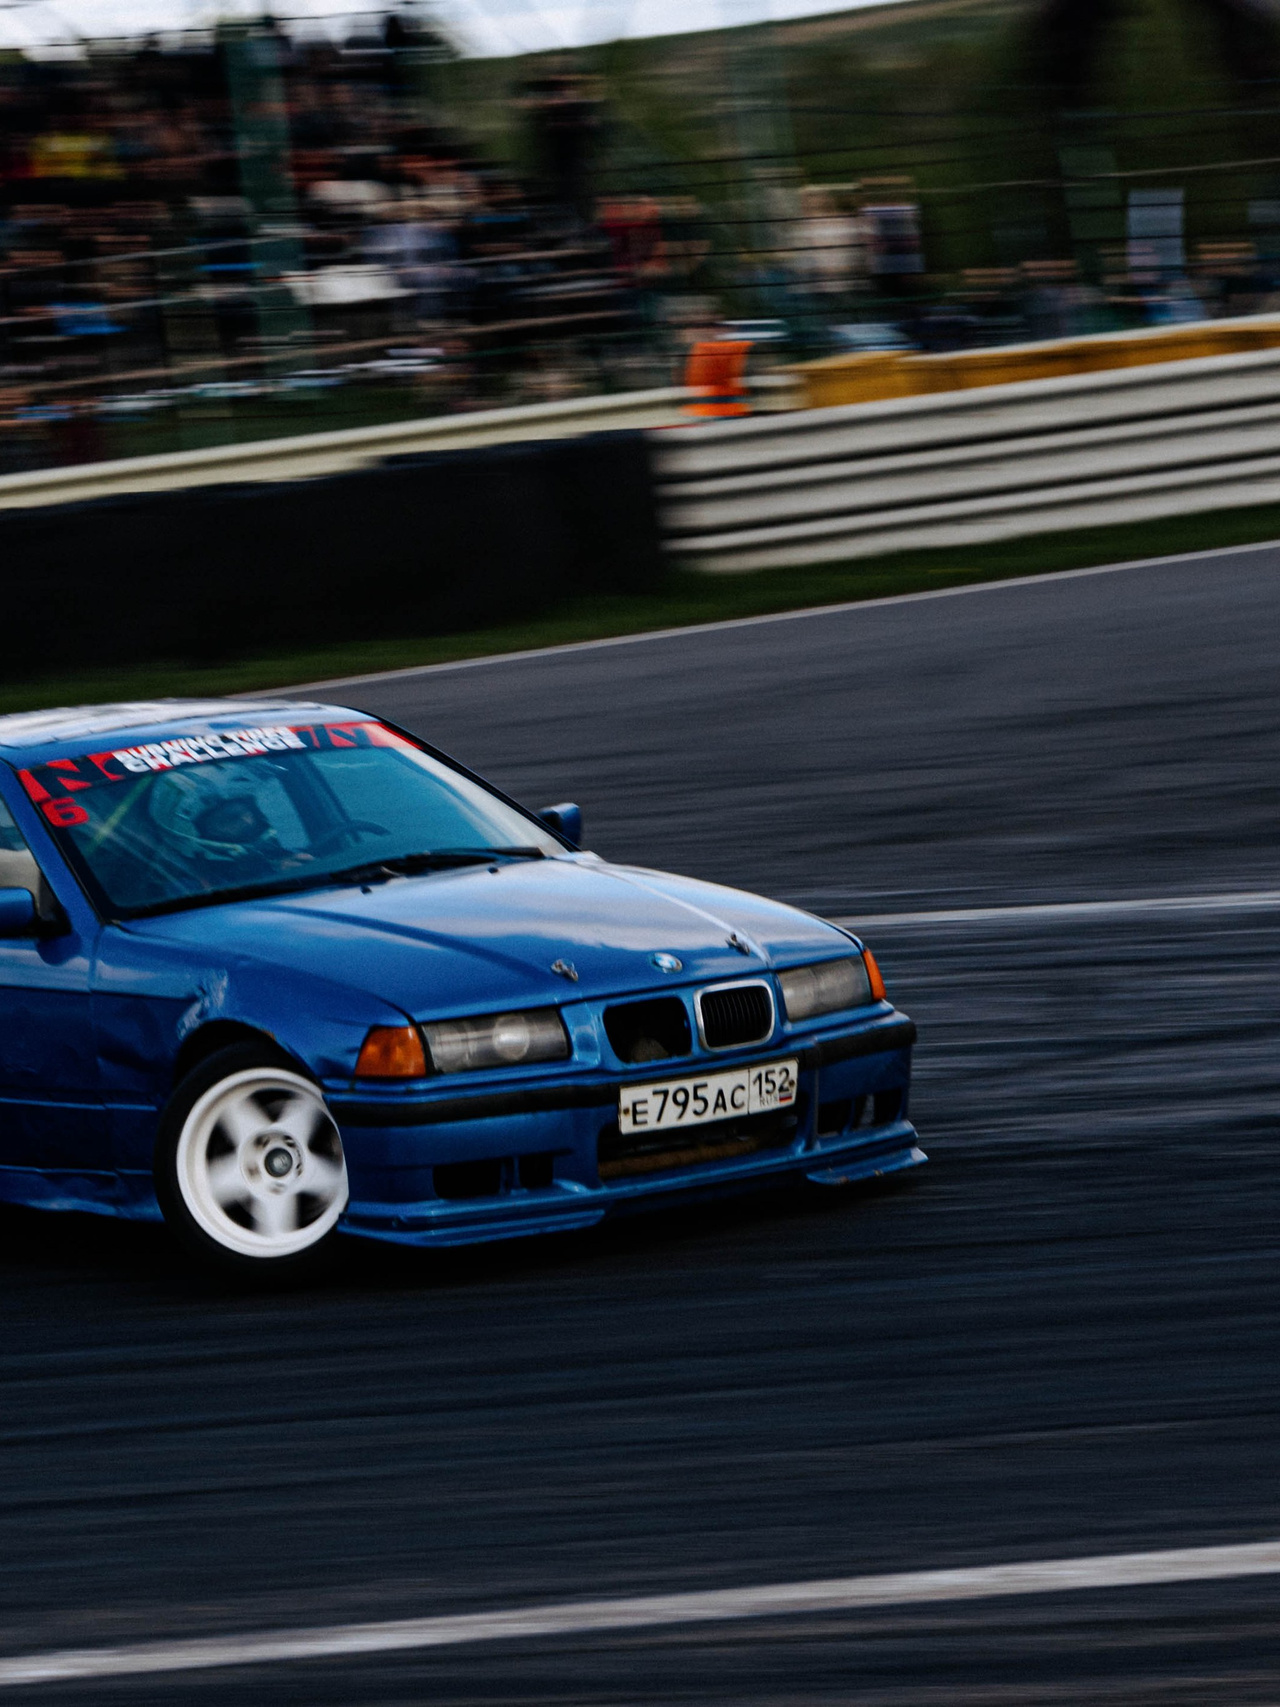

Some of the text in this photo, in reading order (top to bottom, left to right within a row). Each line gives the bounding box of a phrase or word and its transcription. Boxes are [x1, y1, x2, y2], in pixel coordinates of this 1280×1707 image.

[122, 737, 308, 773] CHALLENGE
[41, 797, 90, 827] 6
[752, 1067, 790, 1097] 152
